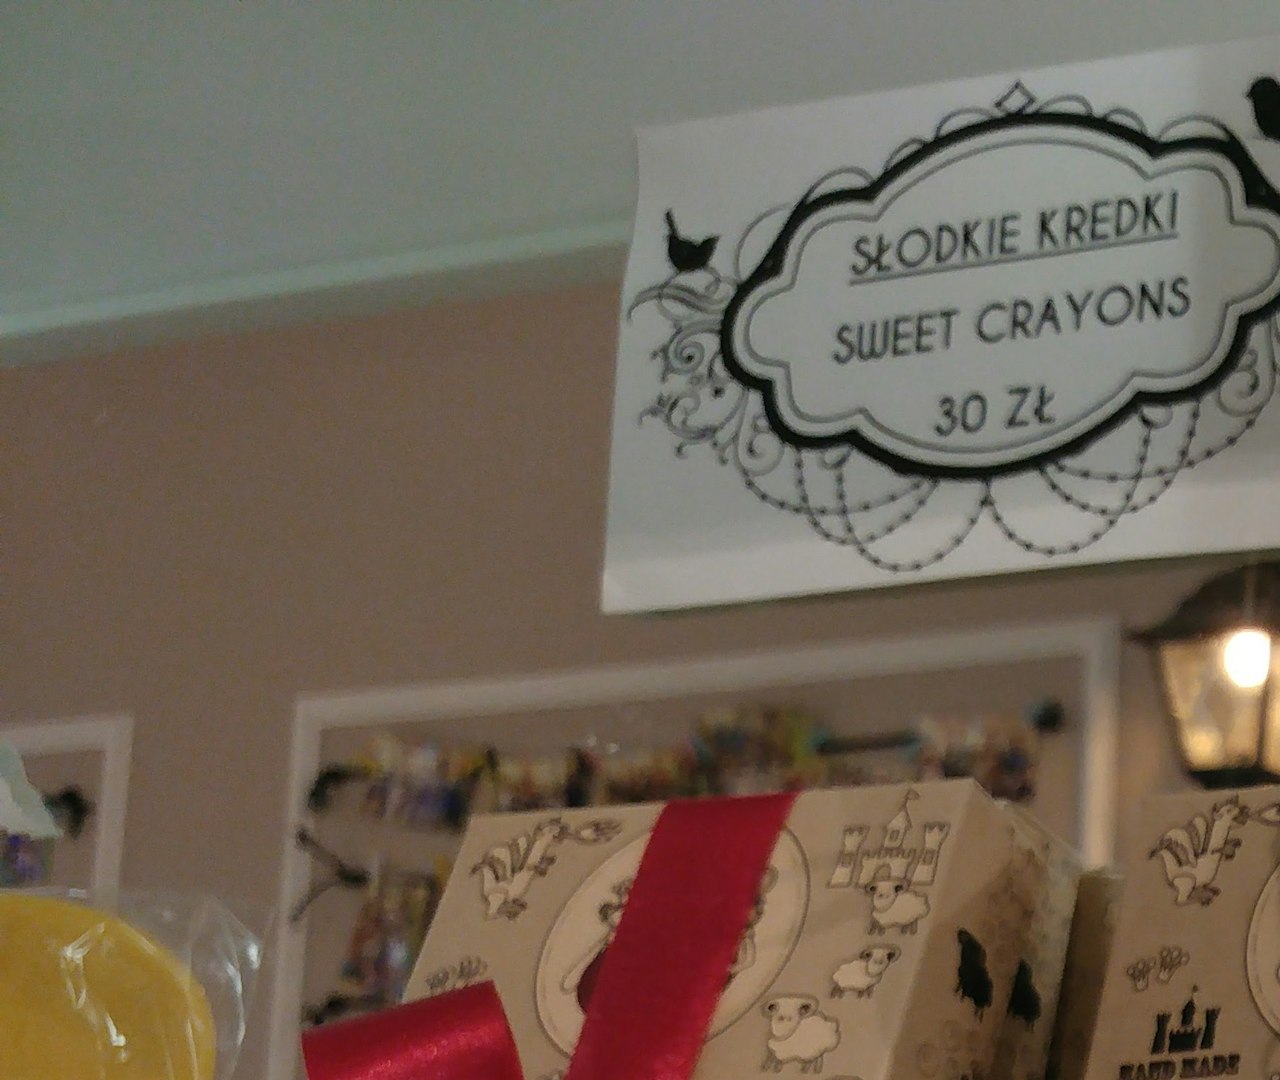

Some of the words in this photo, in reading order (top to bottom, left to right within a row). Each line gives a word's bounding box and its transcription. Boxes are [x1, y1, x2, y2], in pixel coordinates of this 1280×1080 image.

[851, 213, 1021, 276] SŁODKIE
[1038, 189, 1179, 251] KREDKI
[832, 307, 959, 365] SWEET
[976, 274, 1192, 343] CRAYONS
[934, 391, 988, 438] 30
[1005, 384, 1057, 430] ZŁ
